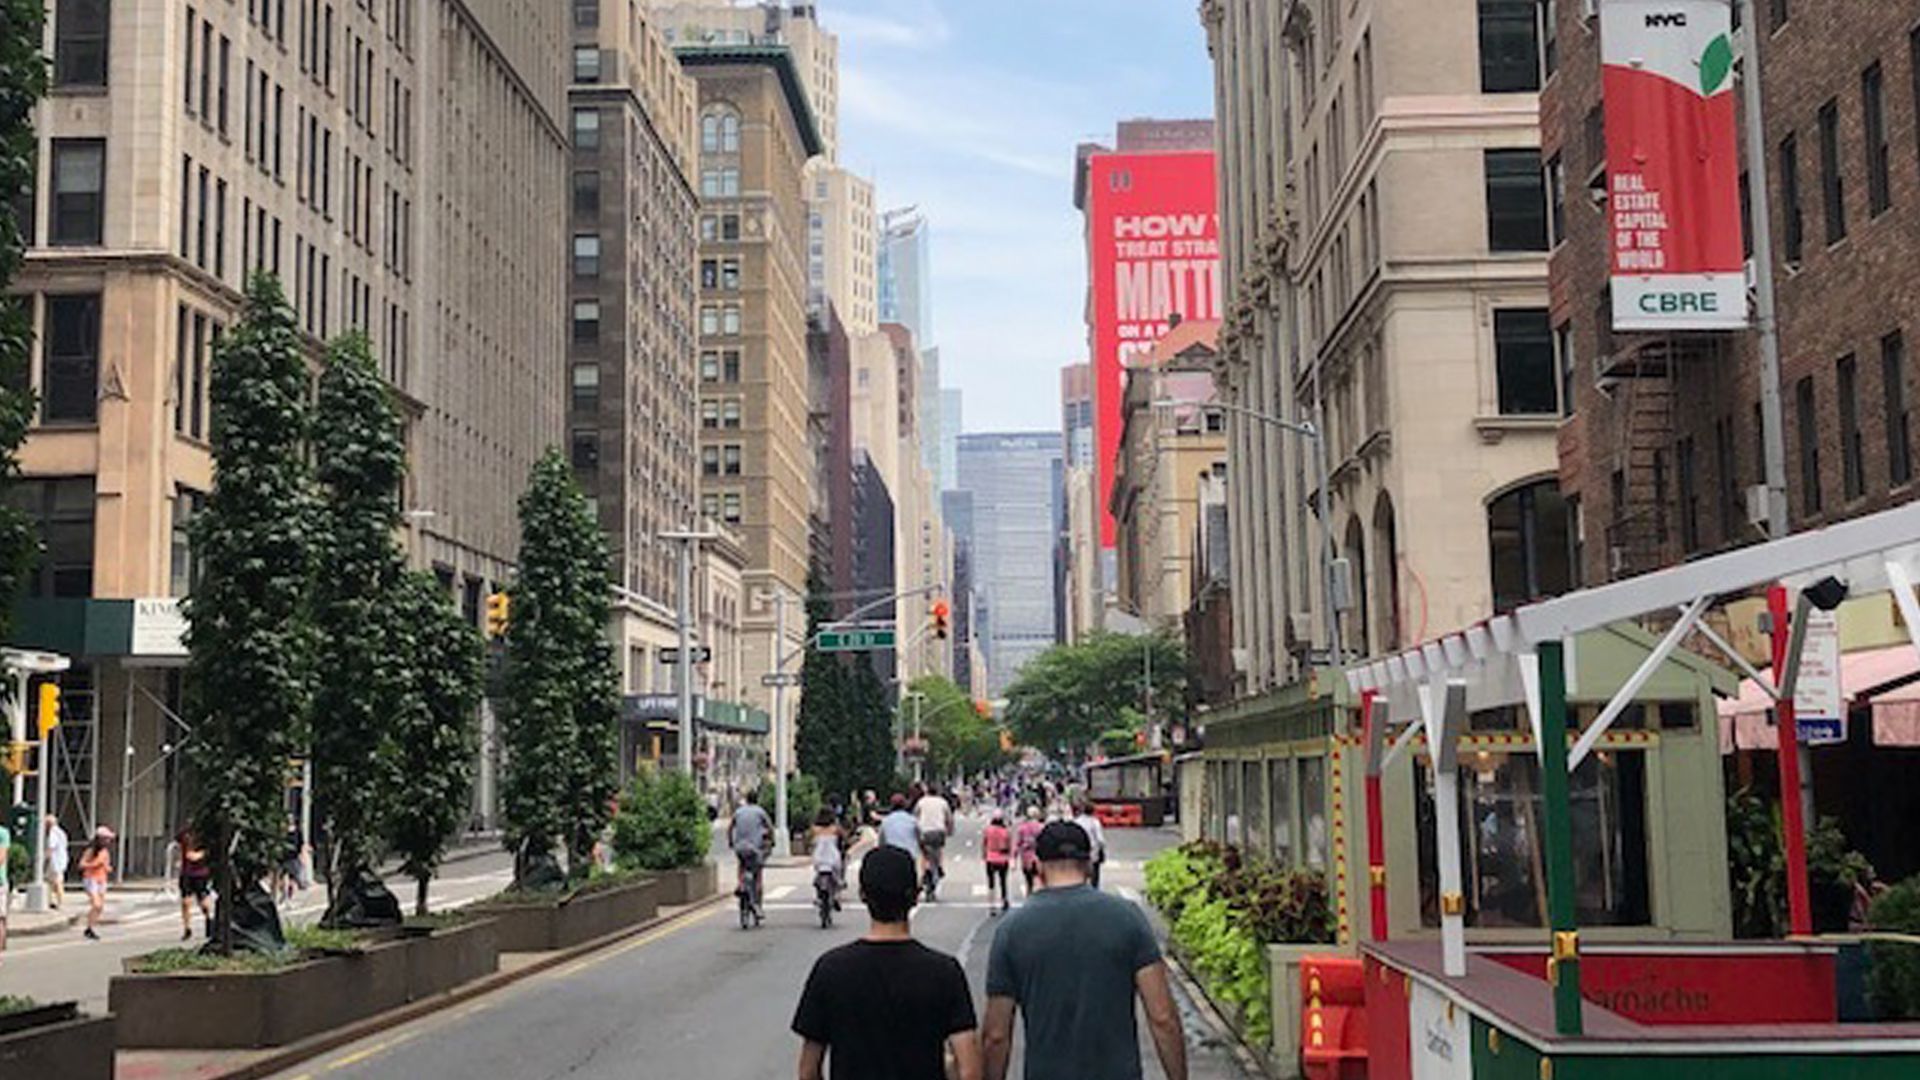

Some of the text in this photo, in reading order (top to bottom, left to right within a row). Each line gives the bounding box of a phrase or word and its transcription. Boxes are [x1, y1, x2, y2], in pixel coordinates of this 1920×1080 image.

[1645, 13, 1686, 27] NYC
[1614, 174, 1645, 192] REAL
[1614, 193, 1660, 210] ESTATE
[1114, 215, 1206, 238] HOW
[1615, 211, 1668, 229] CAPITAL
[1616, 230, 1660, 248] OF THE
[1115, 241, 1168, 257] TREAT
[1616, 249, 1665, 269] WORLD
[1639, 293, 1719, 312] CBRE
